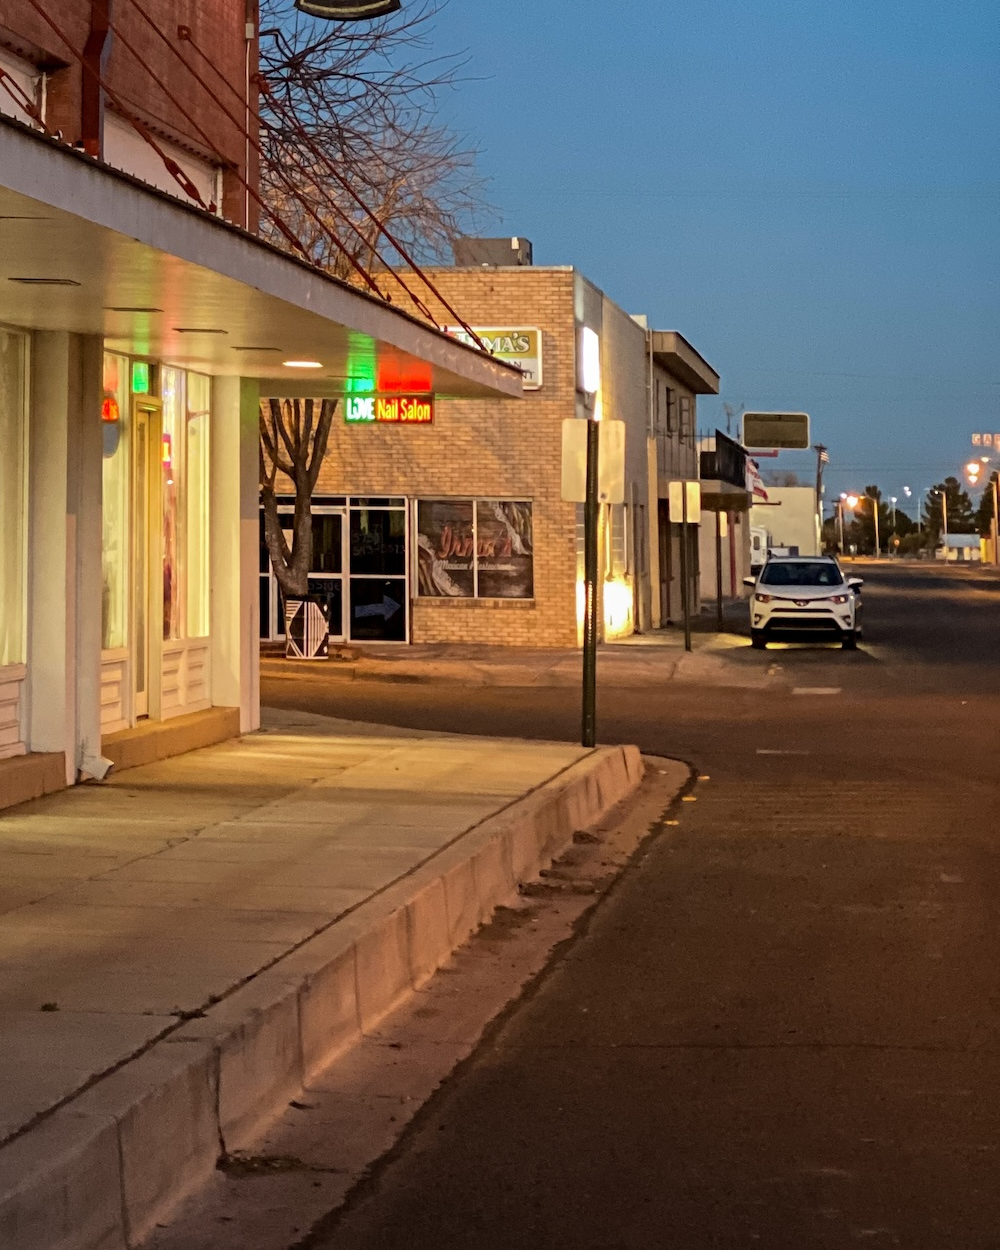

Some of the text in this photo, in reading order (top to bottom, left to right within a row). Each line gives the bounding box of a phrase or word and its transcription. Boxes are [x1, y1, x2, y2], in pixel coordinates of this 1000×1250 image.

[346, 397, 431, 421] LOVE Nail Salon
